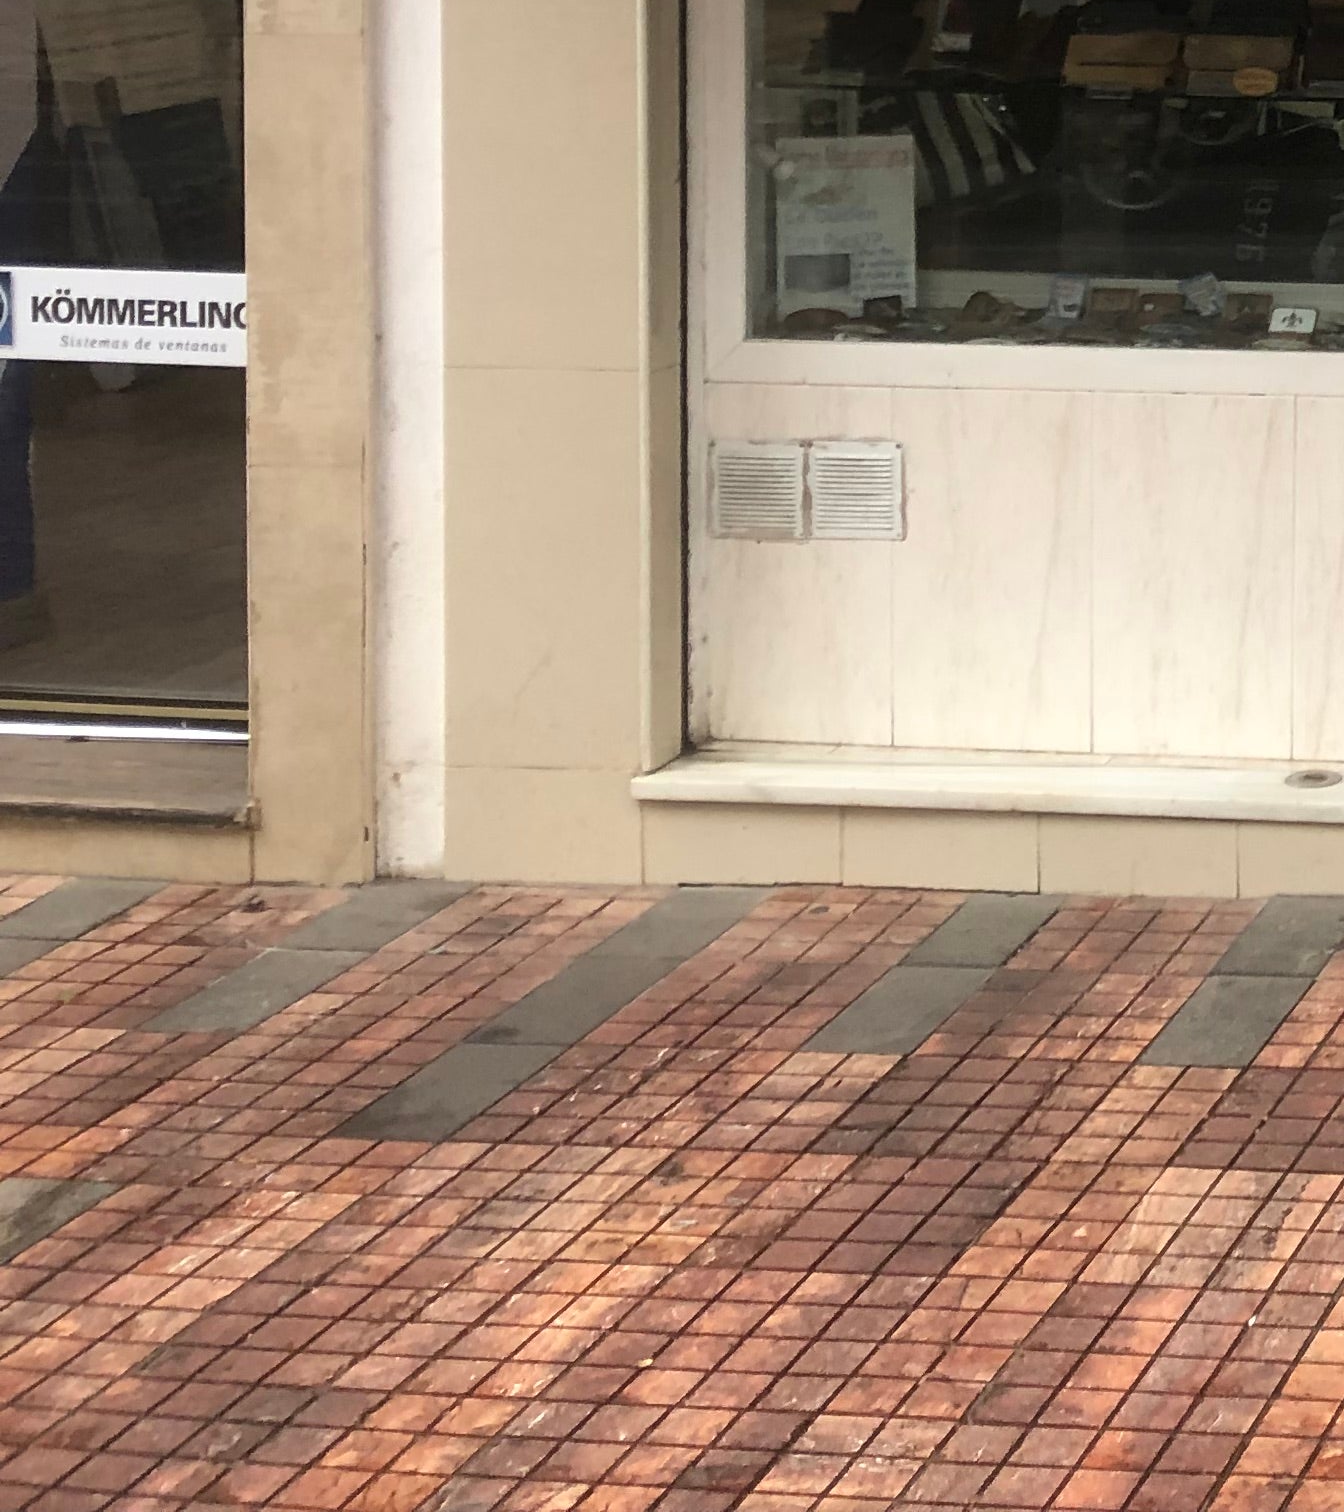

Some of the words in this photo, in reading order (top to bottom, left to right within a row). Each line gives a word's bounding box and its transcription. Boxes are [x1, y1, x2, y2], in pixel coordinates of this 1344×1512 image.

[60, 335, 129, 350] Sistemas
[134, 337, 152, 351] de
[159, 340, 227, 353] ventanas
